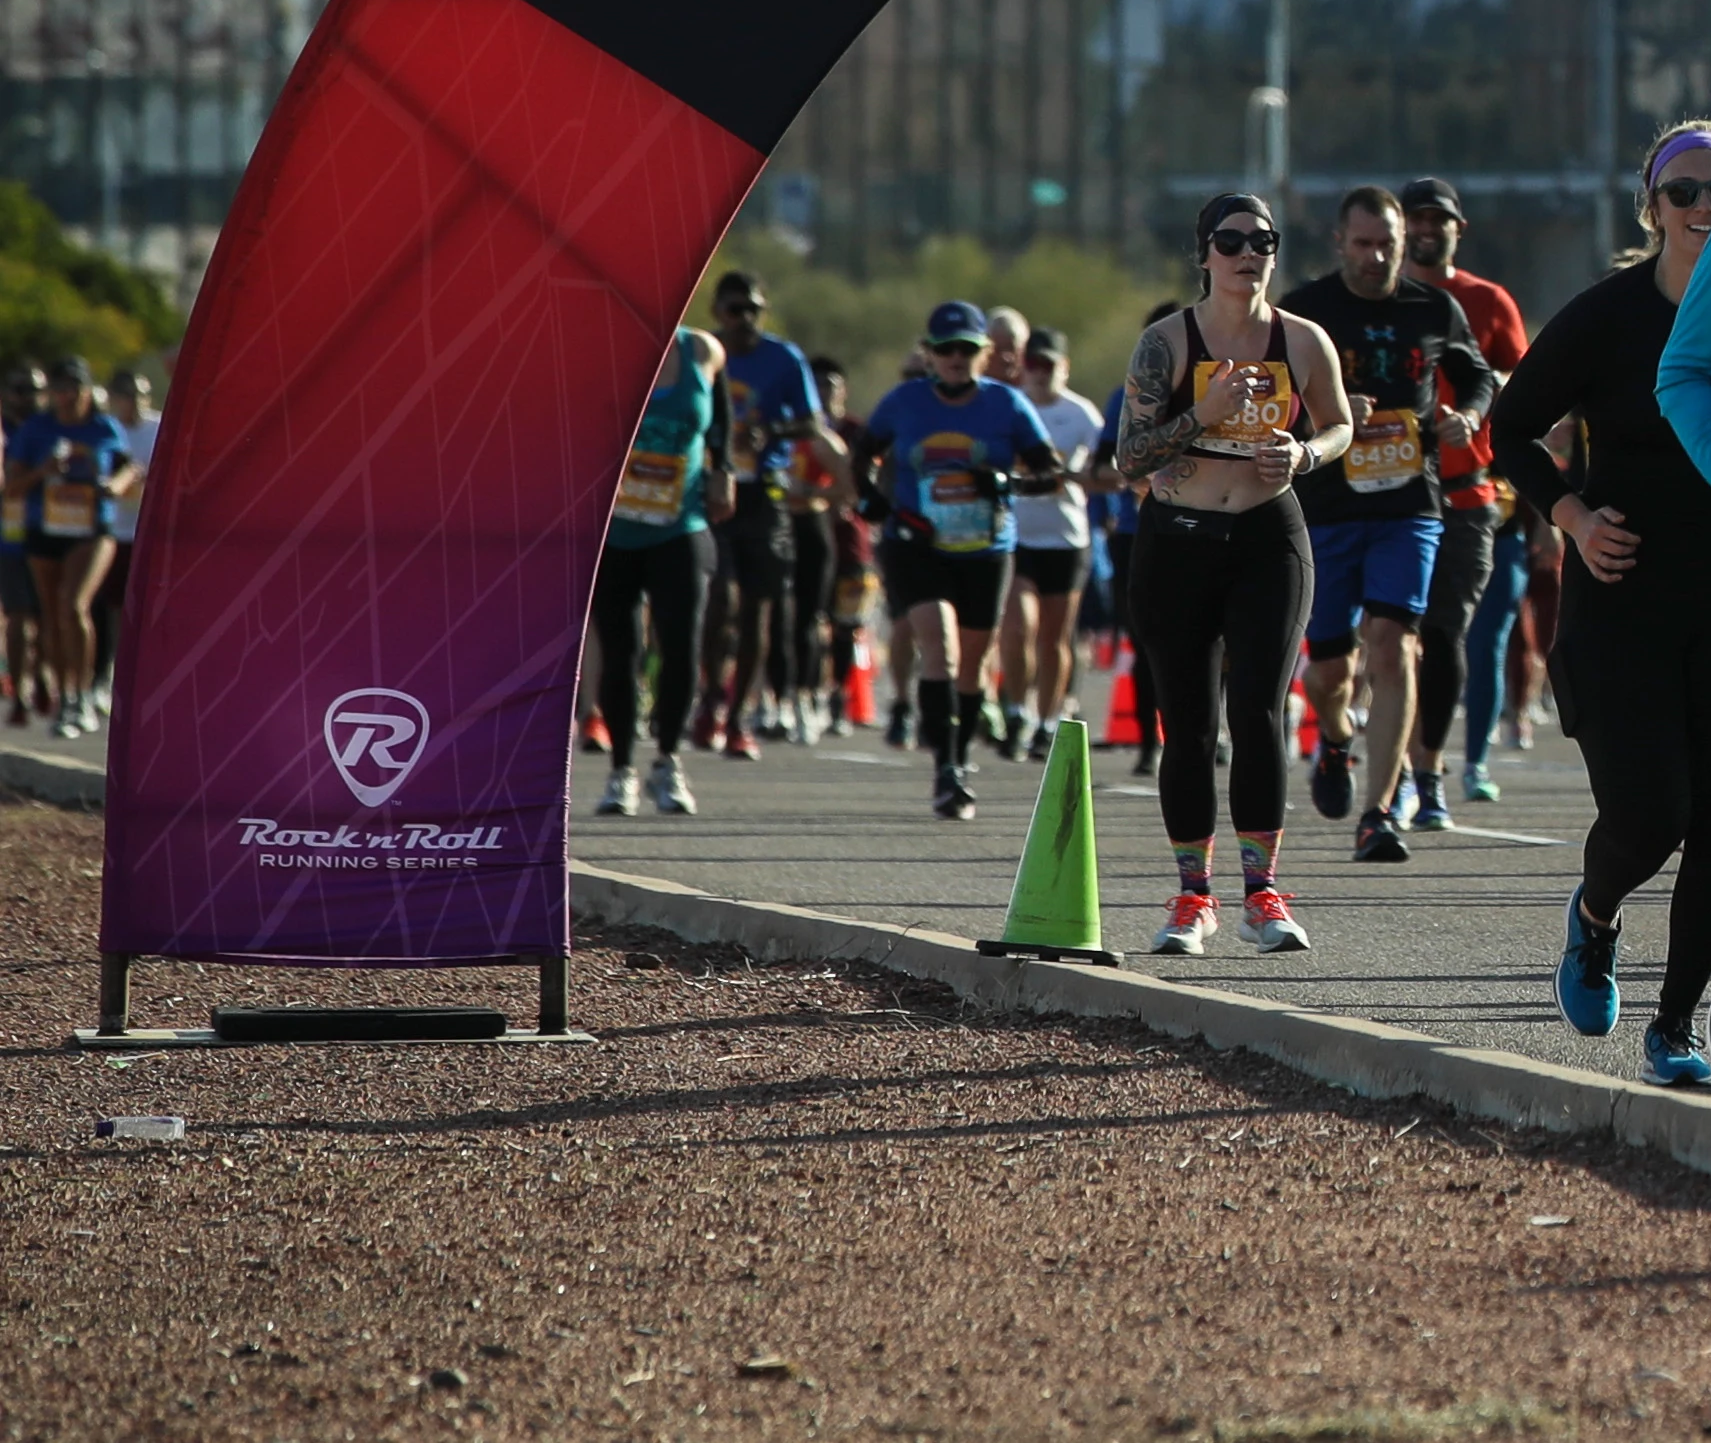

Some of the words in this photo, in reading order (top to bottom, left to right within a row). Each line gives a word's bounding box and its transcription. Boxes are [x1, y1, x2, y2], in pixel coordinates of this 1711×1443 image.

[1350, 442, 1415, 466] 6490
[237, 817, 362, 848] Rock
[402, 823, 503, 849] Roll
[259, 854, 378, 869] RUNNING
[386, 857, 478, 869] SERIES
